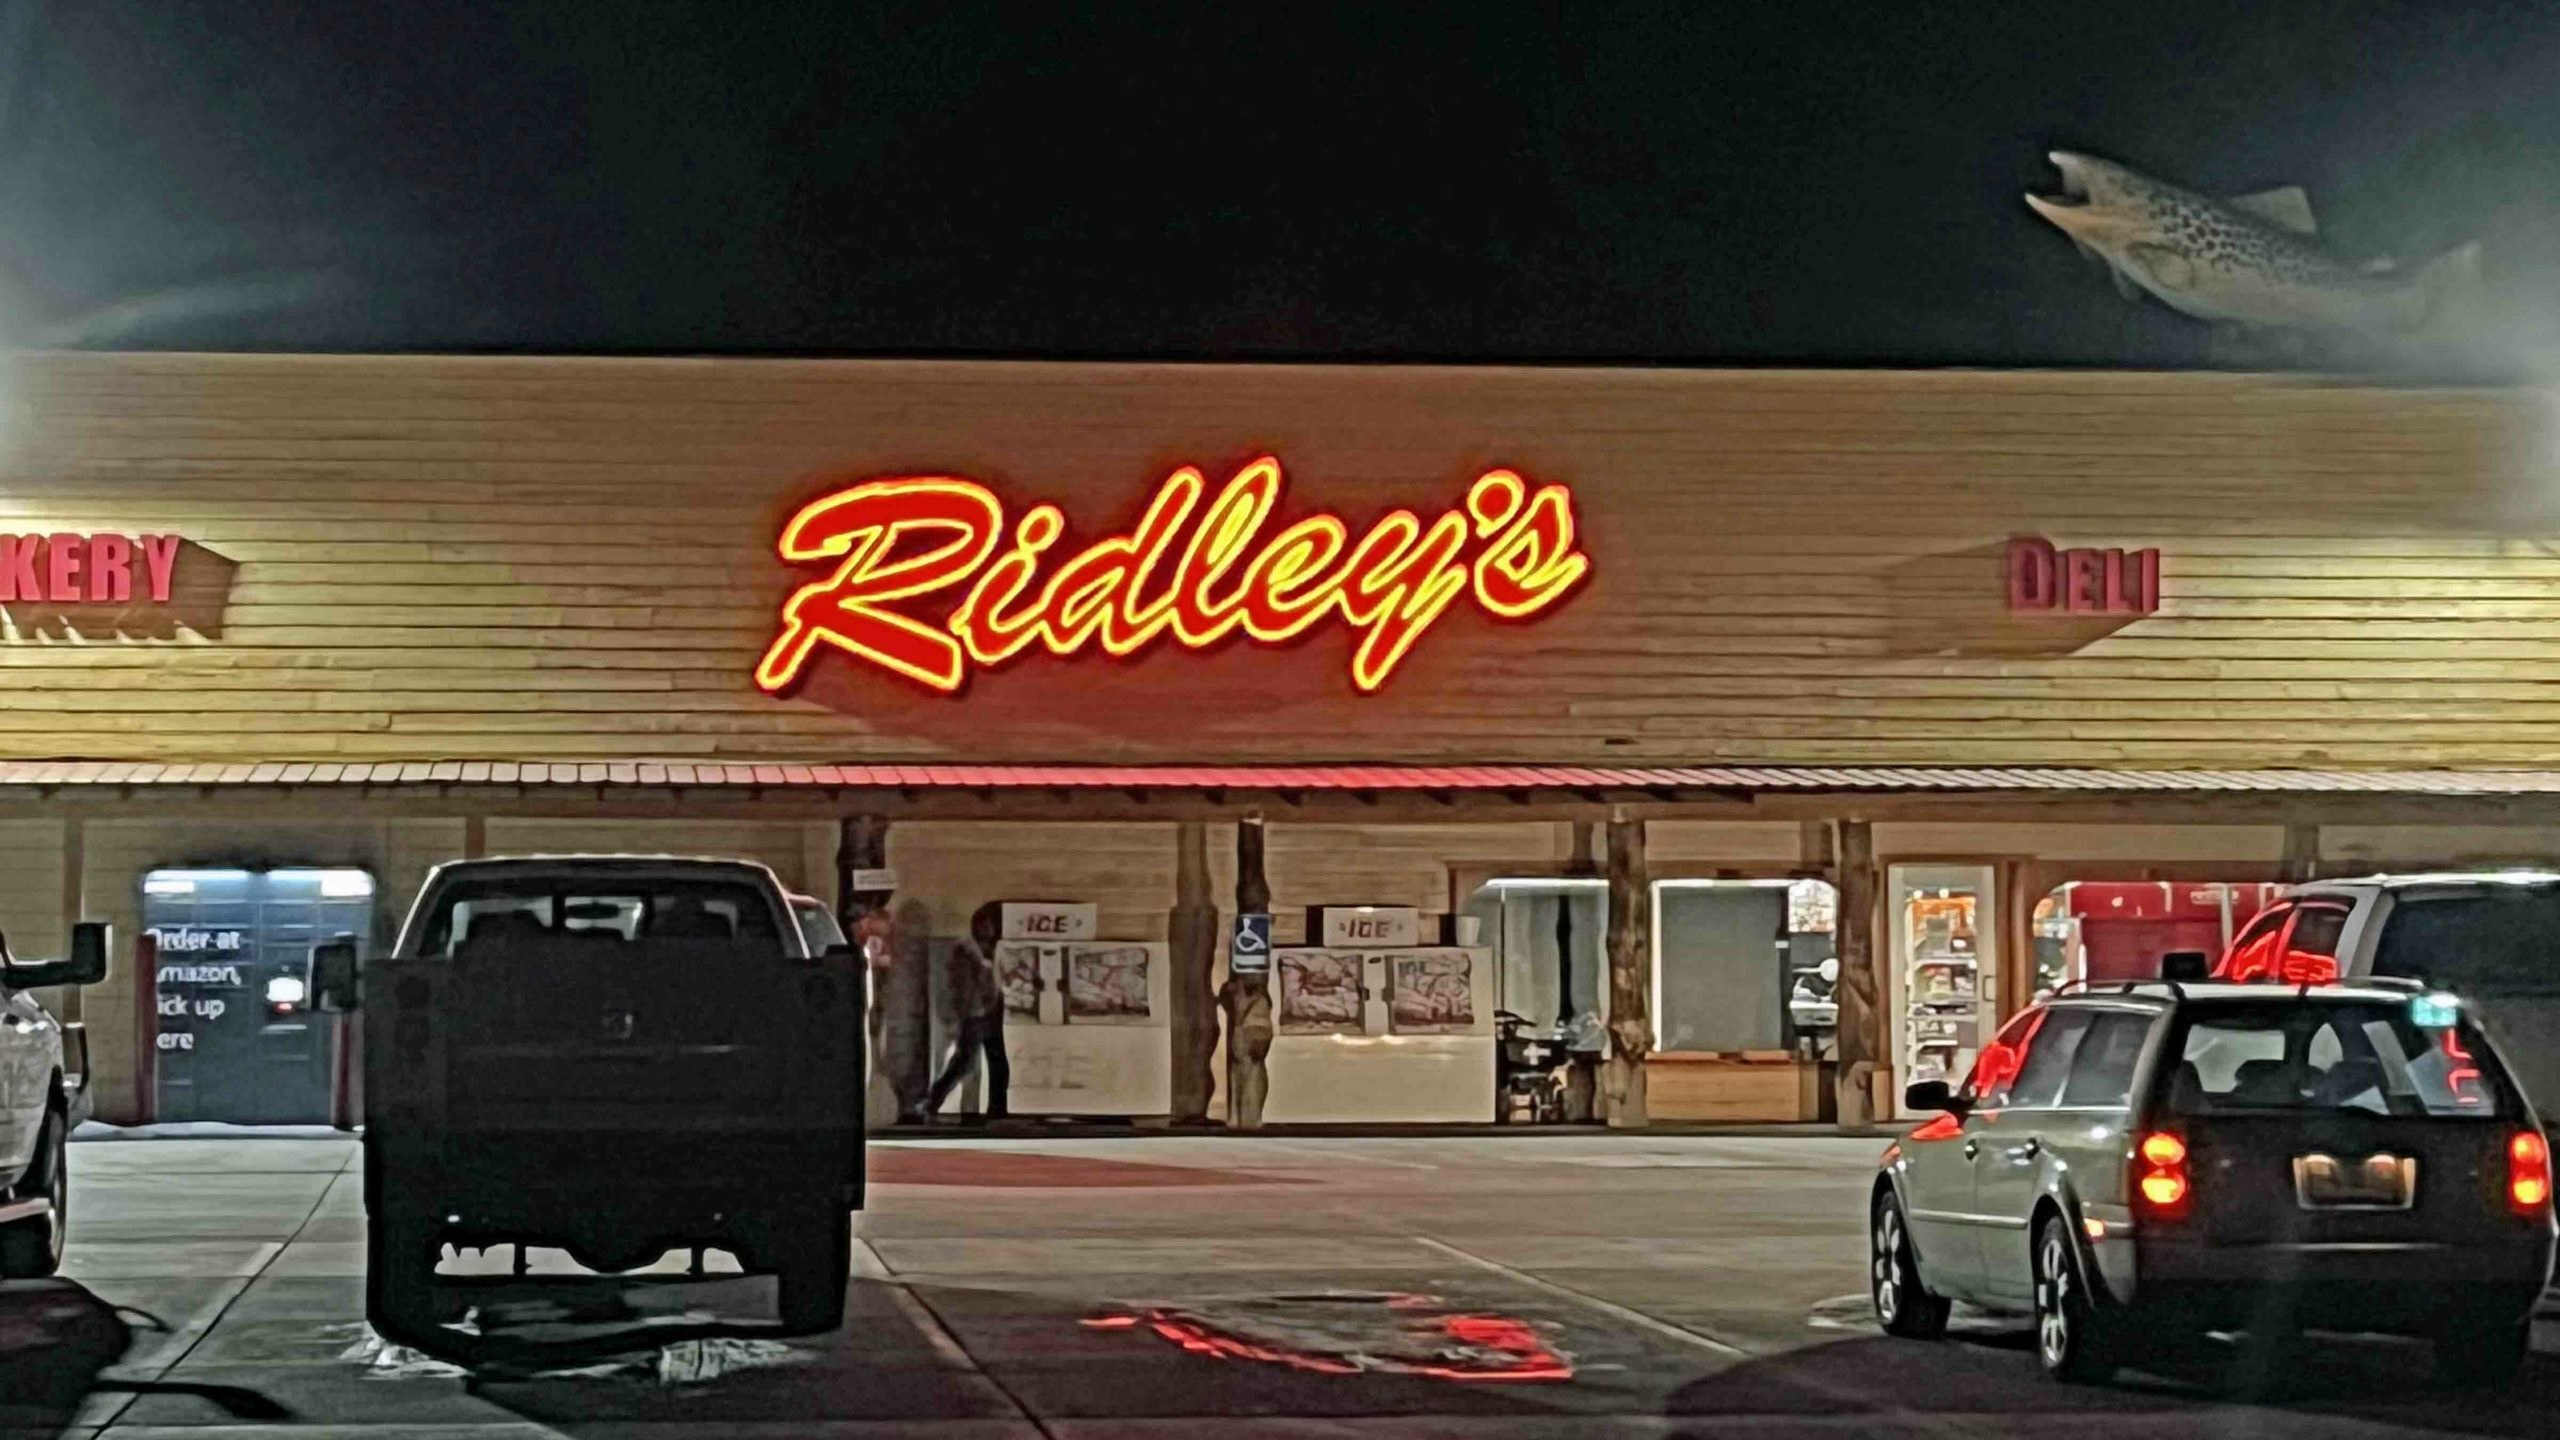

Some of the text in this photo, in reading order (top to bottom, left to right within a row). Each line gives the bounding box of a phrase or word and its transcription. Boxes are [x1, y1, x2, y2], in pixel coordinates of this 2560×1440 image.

[0, 533, 180, 602] KERY
[755, 456, 1590, 693] Ridley's
[2008, 538, 2160, 613] DELI
[1027, 914, 1068, 933] ICE
[1348, 919, 1391, 938] ICE
[217, 931, 241, 950] at
[157, 966, 242, 986] mazon,
[157, 994, 226, 1020] ick up
[156, 1033, 194, 1050] ere
